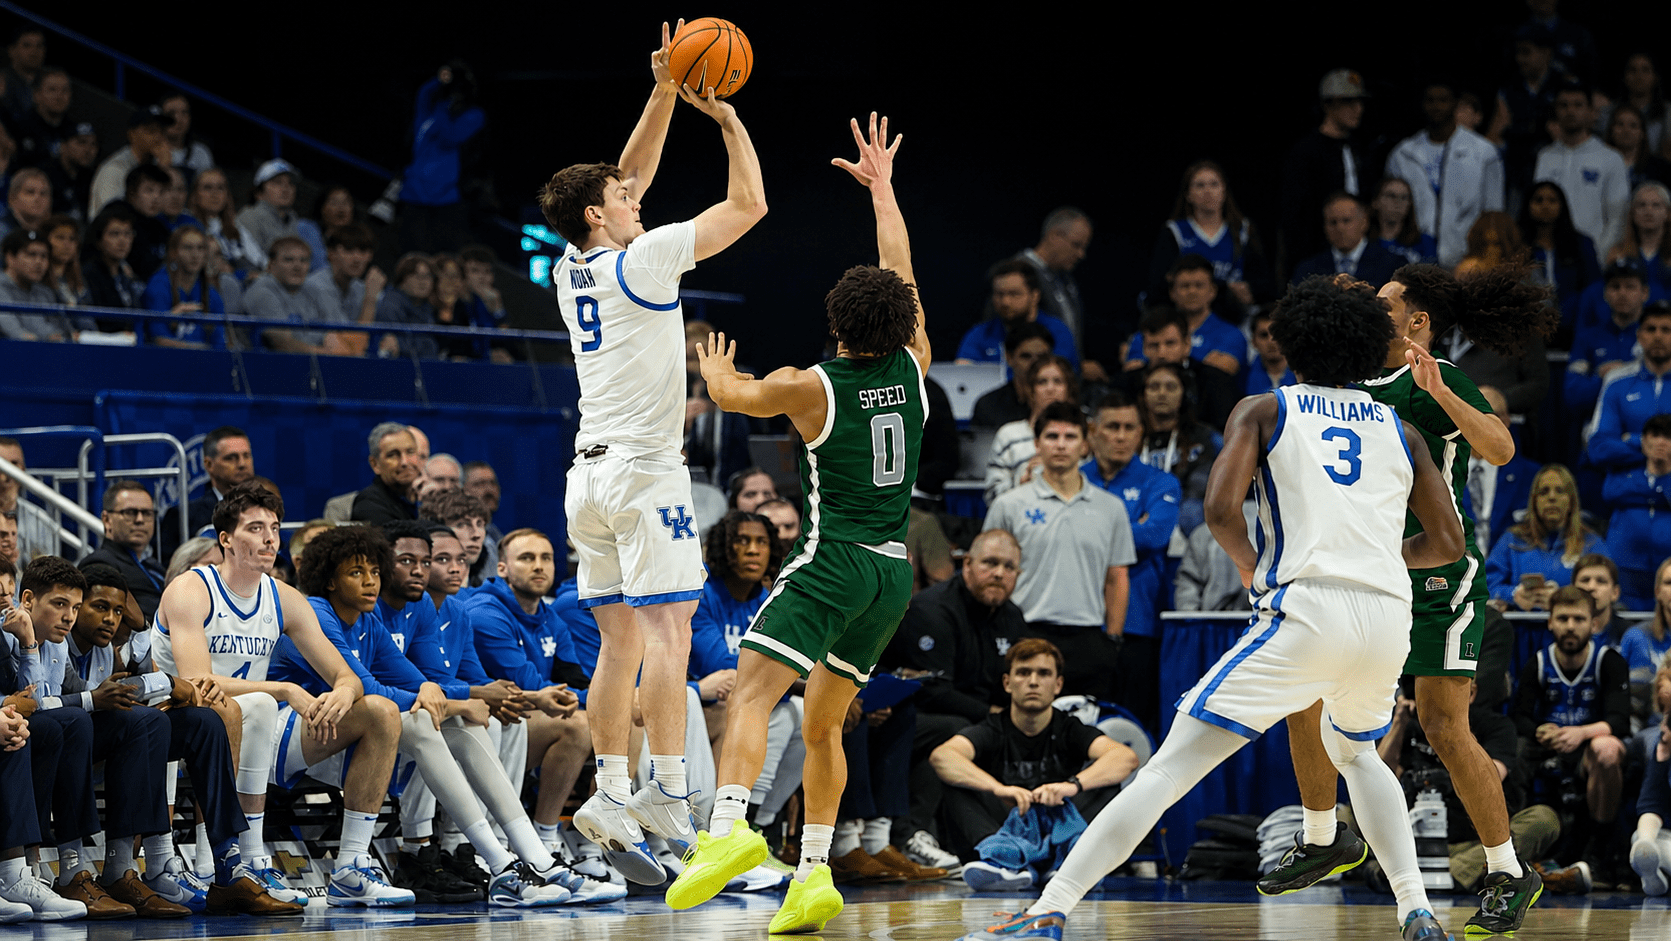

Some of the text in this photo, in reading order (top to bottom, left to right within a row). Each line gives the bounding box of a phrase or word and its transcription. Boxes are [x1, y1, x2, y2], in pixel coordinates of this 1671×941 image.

[569, 267, 596, 289] NOAH
[575, 295, 602, 352] 9
[858, 384, 907, 409] SPEED
[1296, 394, 1384, 423] WILLIAMS
[870, 412, 906, 487] 0
[1321, 426, 1362, 486] 3
[656, 504, 697, 541] UK
[209, 634, 275, 657] KENTUCKY
[1465, 642, 1475, 658] L
